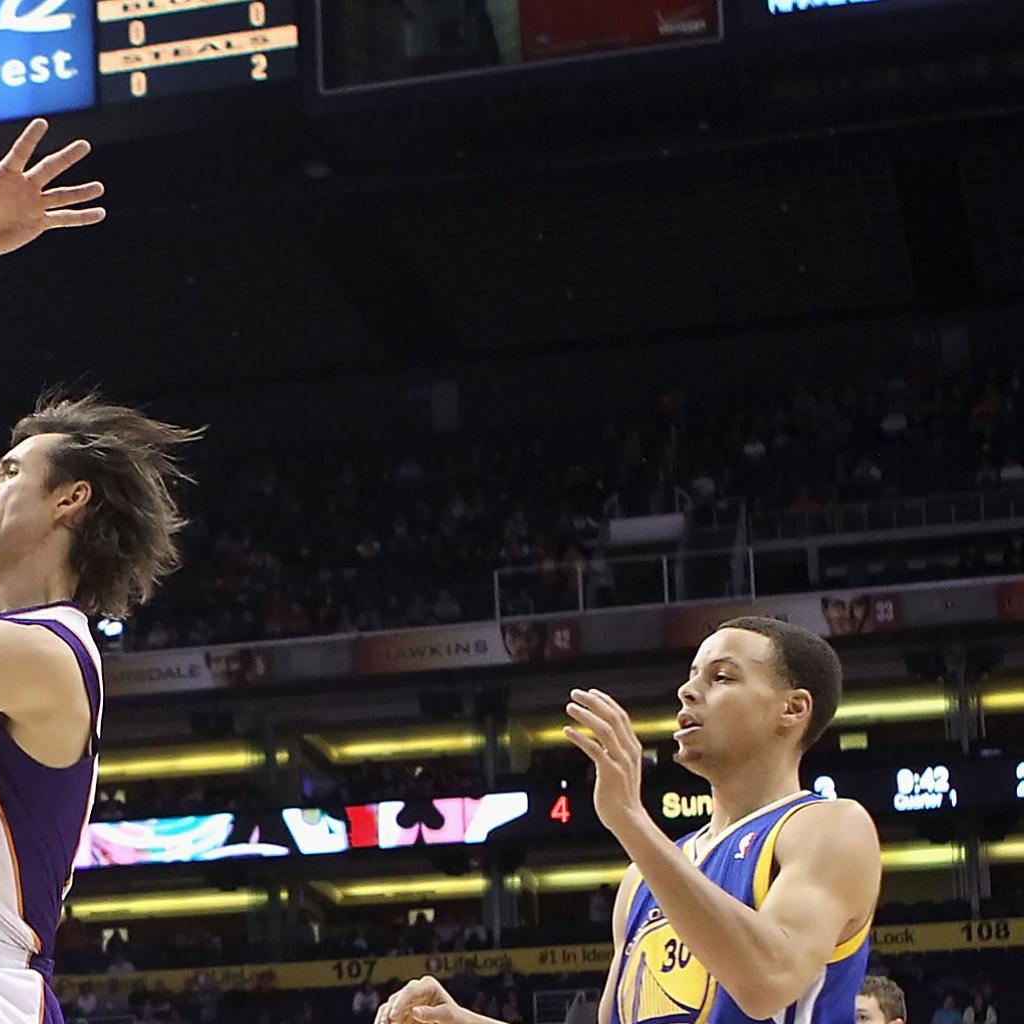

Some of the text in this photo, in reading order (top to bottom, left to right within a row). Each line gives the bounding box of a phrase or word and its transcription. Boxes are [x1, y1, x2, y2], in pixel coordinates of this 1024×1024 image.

[121, 34, 269, 65] STEALS
[250, 53, 268, 81] 2
[549, 795, 571, 824] 4
[960, 921, 1011, 942] 108
[332, 960, 375, 980] 107
